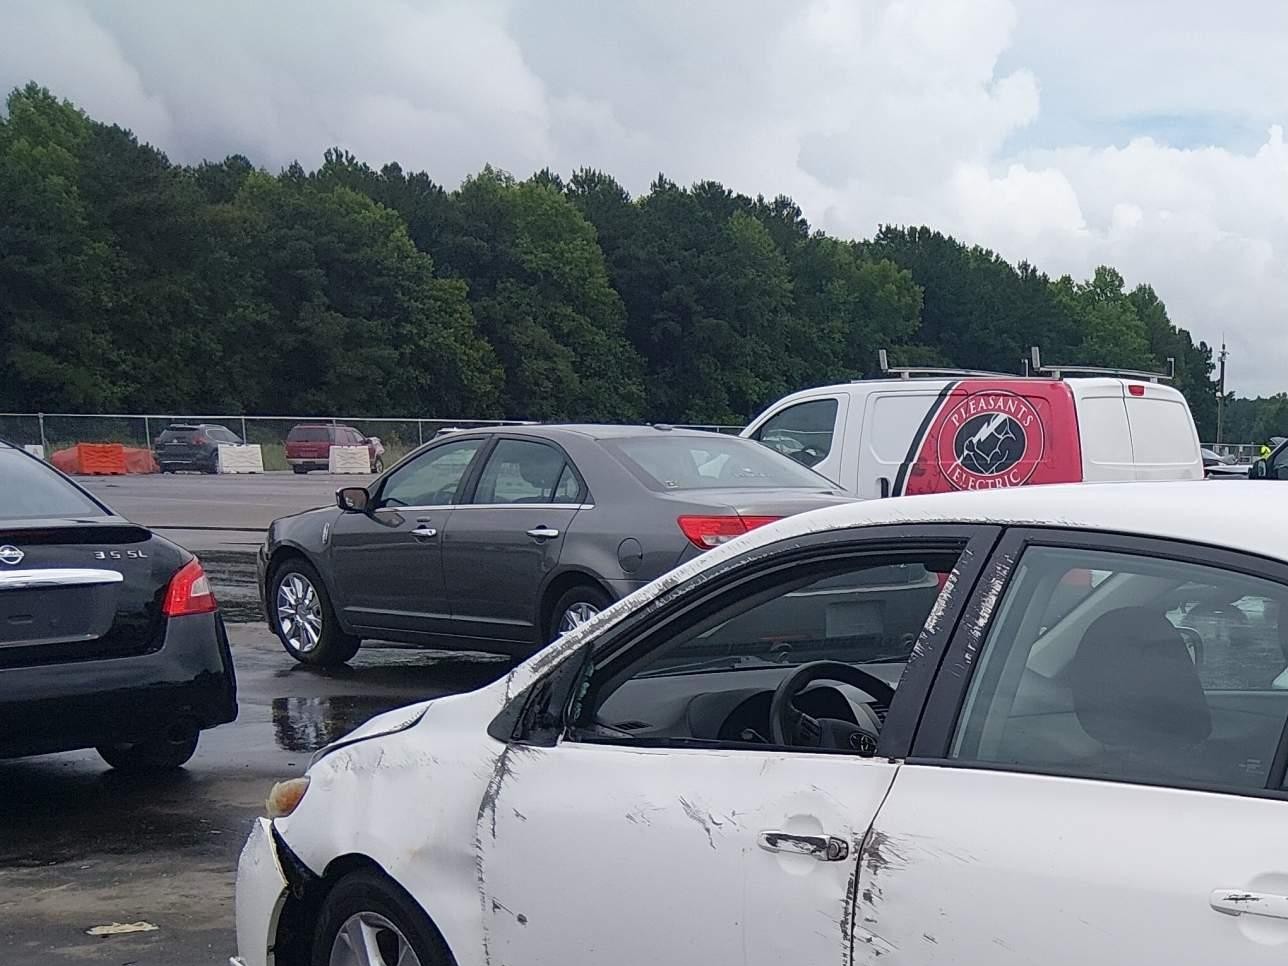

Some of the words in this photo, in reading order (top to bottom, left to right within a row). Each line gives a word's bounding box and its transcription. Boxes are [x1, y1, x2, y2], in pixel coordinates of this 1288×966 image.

[951, 395, 1034, 427] PLEASANTS
[953, 469, 1021, 491] ELECTRIC
[127, 549, 149, 559] SL
